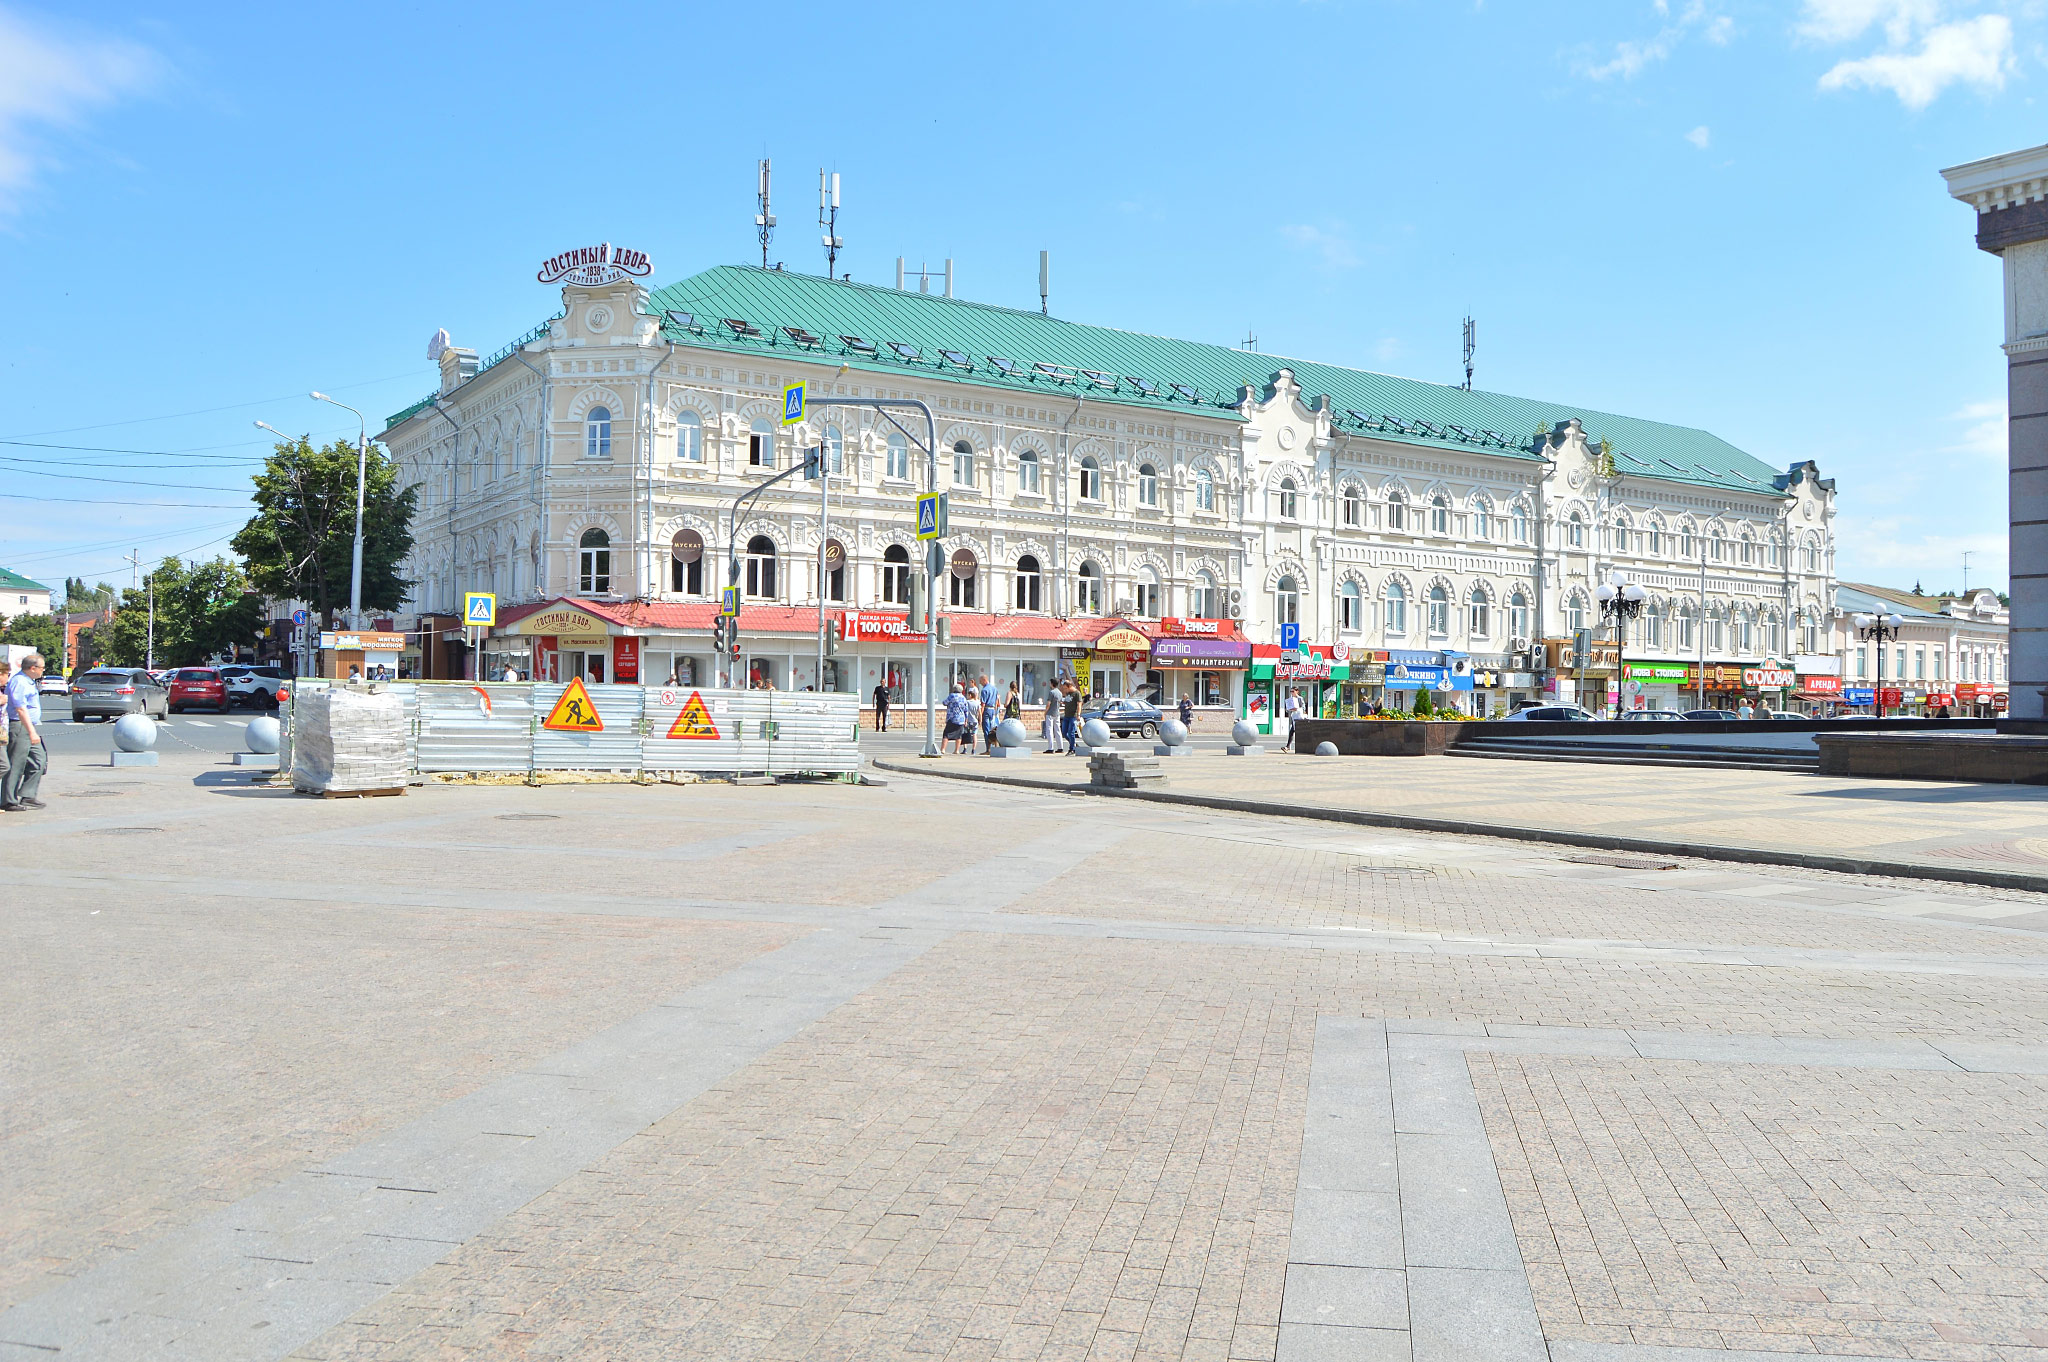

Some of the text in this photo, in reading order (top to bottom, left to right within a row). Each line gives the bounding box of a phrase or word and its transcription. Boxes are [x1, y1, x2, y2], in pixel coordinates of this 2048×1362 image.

[543, 243, 647, 276] ГОСТИНЫЙ ДВОР
[587, 266, 600, 276] 1838
[569, 274, 604, 283] ТОРГОВЫЙ
[537, 612, 589, 627] ГОСТИНЫЙ ДВОР
[860, 622, 881, 633] 100
[1156, 642, 1191, 654] familia
[1564, 648, 1604, 662] ГОНЫЙ
[1191, 658, 1243, 667] КОНДИТЕРСКАЯ
[1275, 663, 1330, 677] КАРАВАН
[1077, 676, 1089, 687] 50
[1744, 670, 1795, 687] СТОЛОВАЯ
[1810, 680, 1837, 690] АРЕНДА
